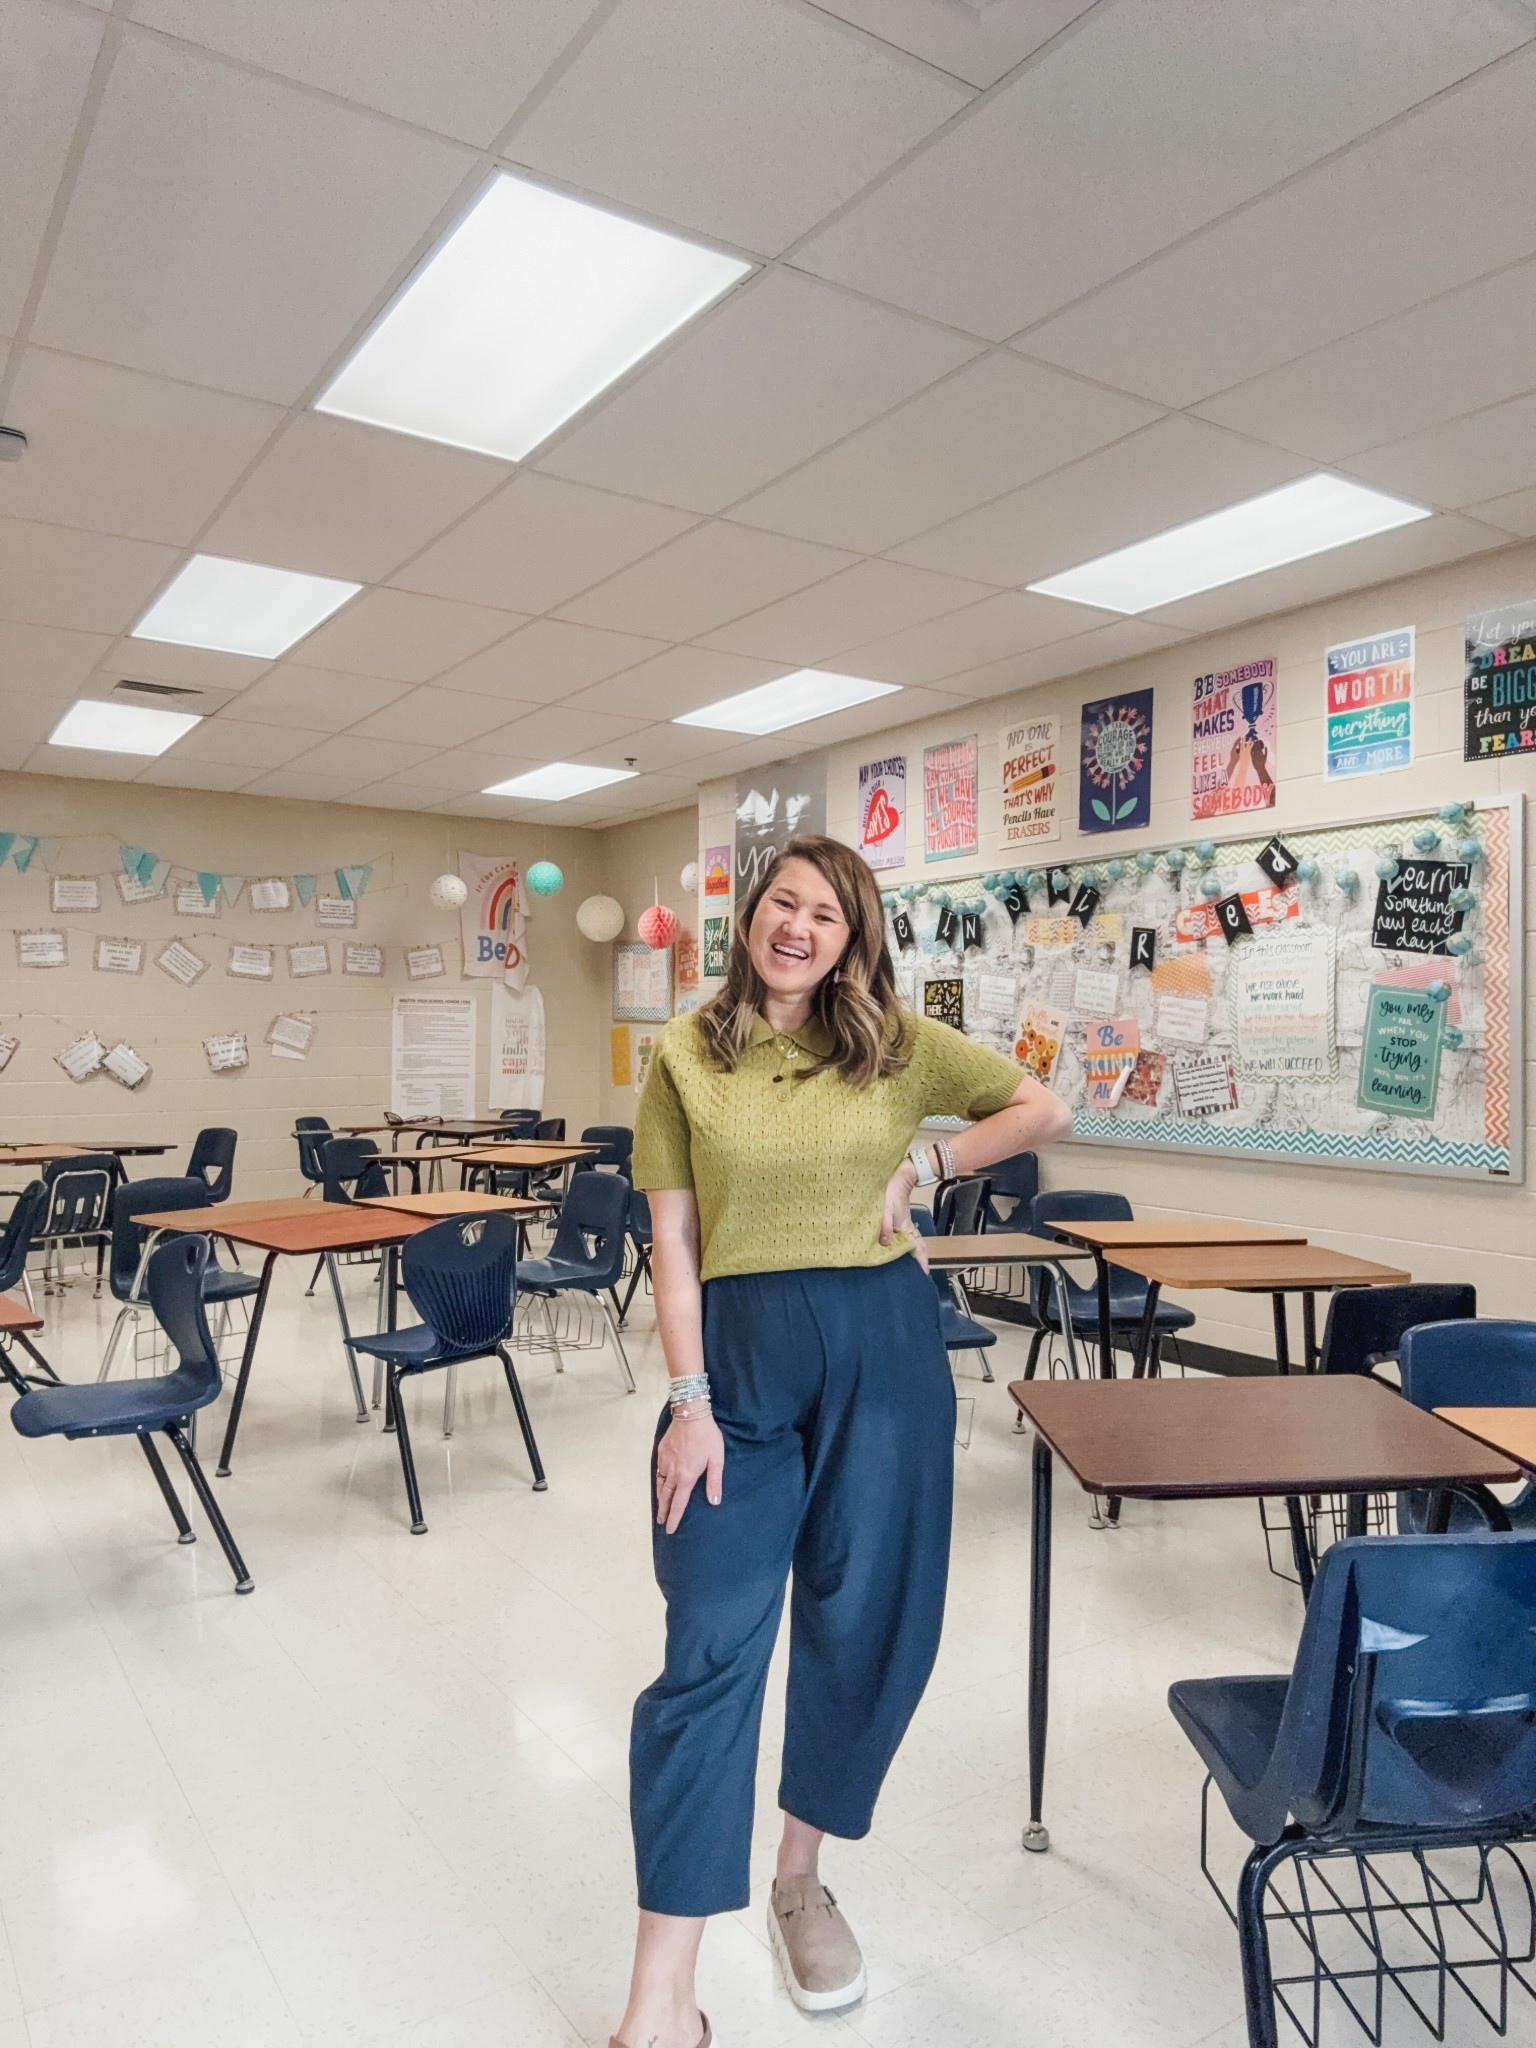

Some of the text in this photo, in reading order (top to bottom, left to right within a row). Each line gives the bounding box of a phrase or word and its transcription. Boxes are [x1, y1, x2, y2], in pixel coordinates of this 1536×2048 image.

[1472, 616, 1503, 647] Let
[1341, 641, 1397, 669] YOU ARE
[1193, 659, 1273, 702] BE SOMEBODY
[1333, 669, 1404, 705] WORTH
[1471, 675, 1488, 691] BE
[1193, 687, 1230, 721] THAT
[1193, 708, 1235, 739] MAKES
[1331, 707, 1408, 742] everything
[1474, 707, 1511, 728] than
[1006, 722, 1053, 750] NO ONE
[1098, 728, 1134, 746] COURAGE
[1479, 729, 1536, 754] FEAR
[1003, 744, 1055, 784] PERFECT
[1193, 753, 1224, 773] FEEL
[1365, 744, 1403, 766] MORE
[954, 776, 976, 800] HAVE
[1193, 769, 1229, 795] LIKE A
[1003, 782, 1055, 810] THAT'S WHY
[1192, 782, 1274, 817] SOMEBODY
[867, 794, 891, 840] HOPES
[1003, 807, 1056, 826] Pencils Have
[1007, 821, 1051, 841] ERASERS
[1376, 915, 1454, 936] new each
[1241, 942, 1313, 960] In this classroom
[1395, 929, 1447, 956] day
[1262, 990, 1283, 1001] work
[1285, 987, 1305, 1001] hard
[1276, 978, 1300, 989] above
[1378, 1001, 1435, 1023] you only
[1398, 1017, 1413, 1026] FAIL
[1097, 1025, 1124, 1047] Be
[1378, 1026, 1430, 1042] WHEN YOU
[1390, 1036, 1417, 1048] STOP
[1090, 1052, 1136, 1077] KIND
[1259, 1057, 1276, 1071] will
[1278, 1056, 1323, 1072] SUCCEED
[1379, 1045, 1422, 1073] trying
